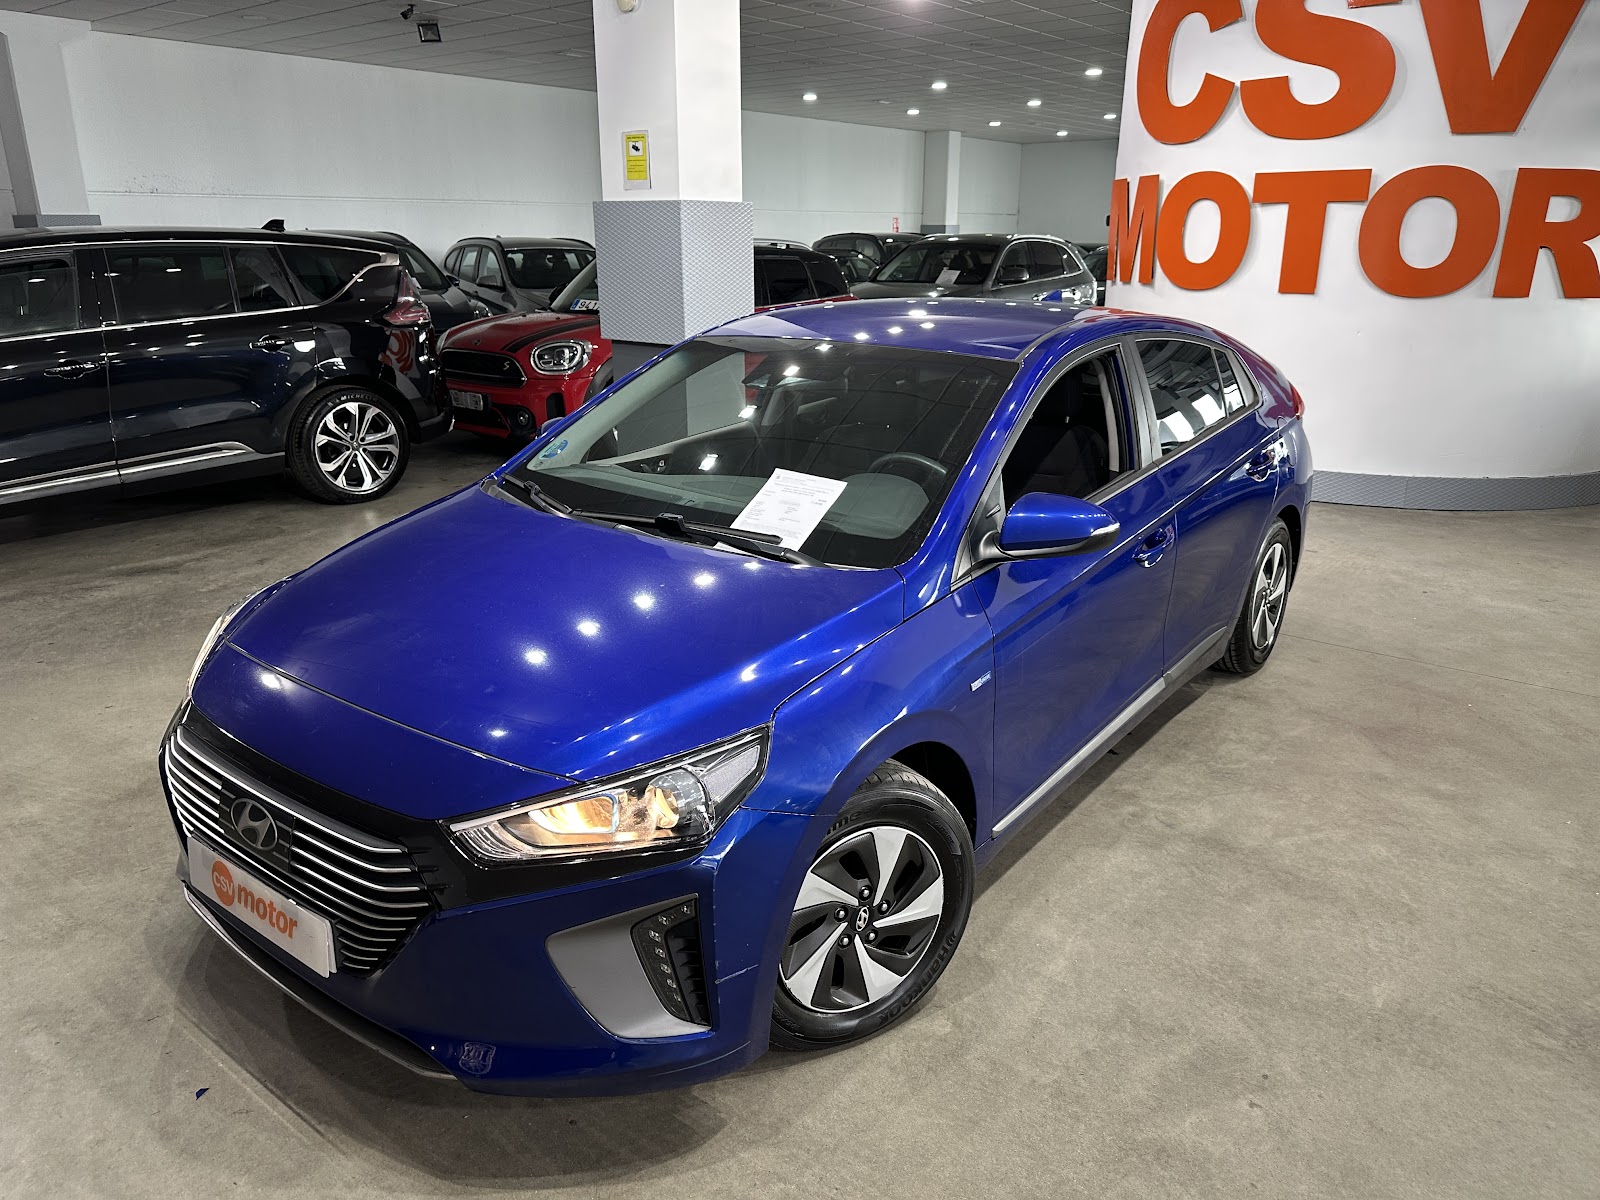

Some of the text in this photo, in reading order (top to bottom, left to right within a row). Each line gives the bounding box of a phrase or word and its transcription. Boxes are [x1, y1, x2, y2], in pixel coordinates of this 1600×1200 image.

[1137, 0, 1588, 145] CSV
[1107, 164, 1600, 298] MOTOR
[212, 871, 298, 939] CSV motor
